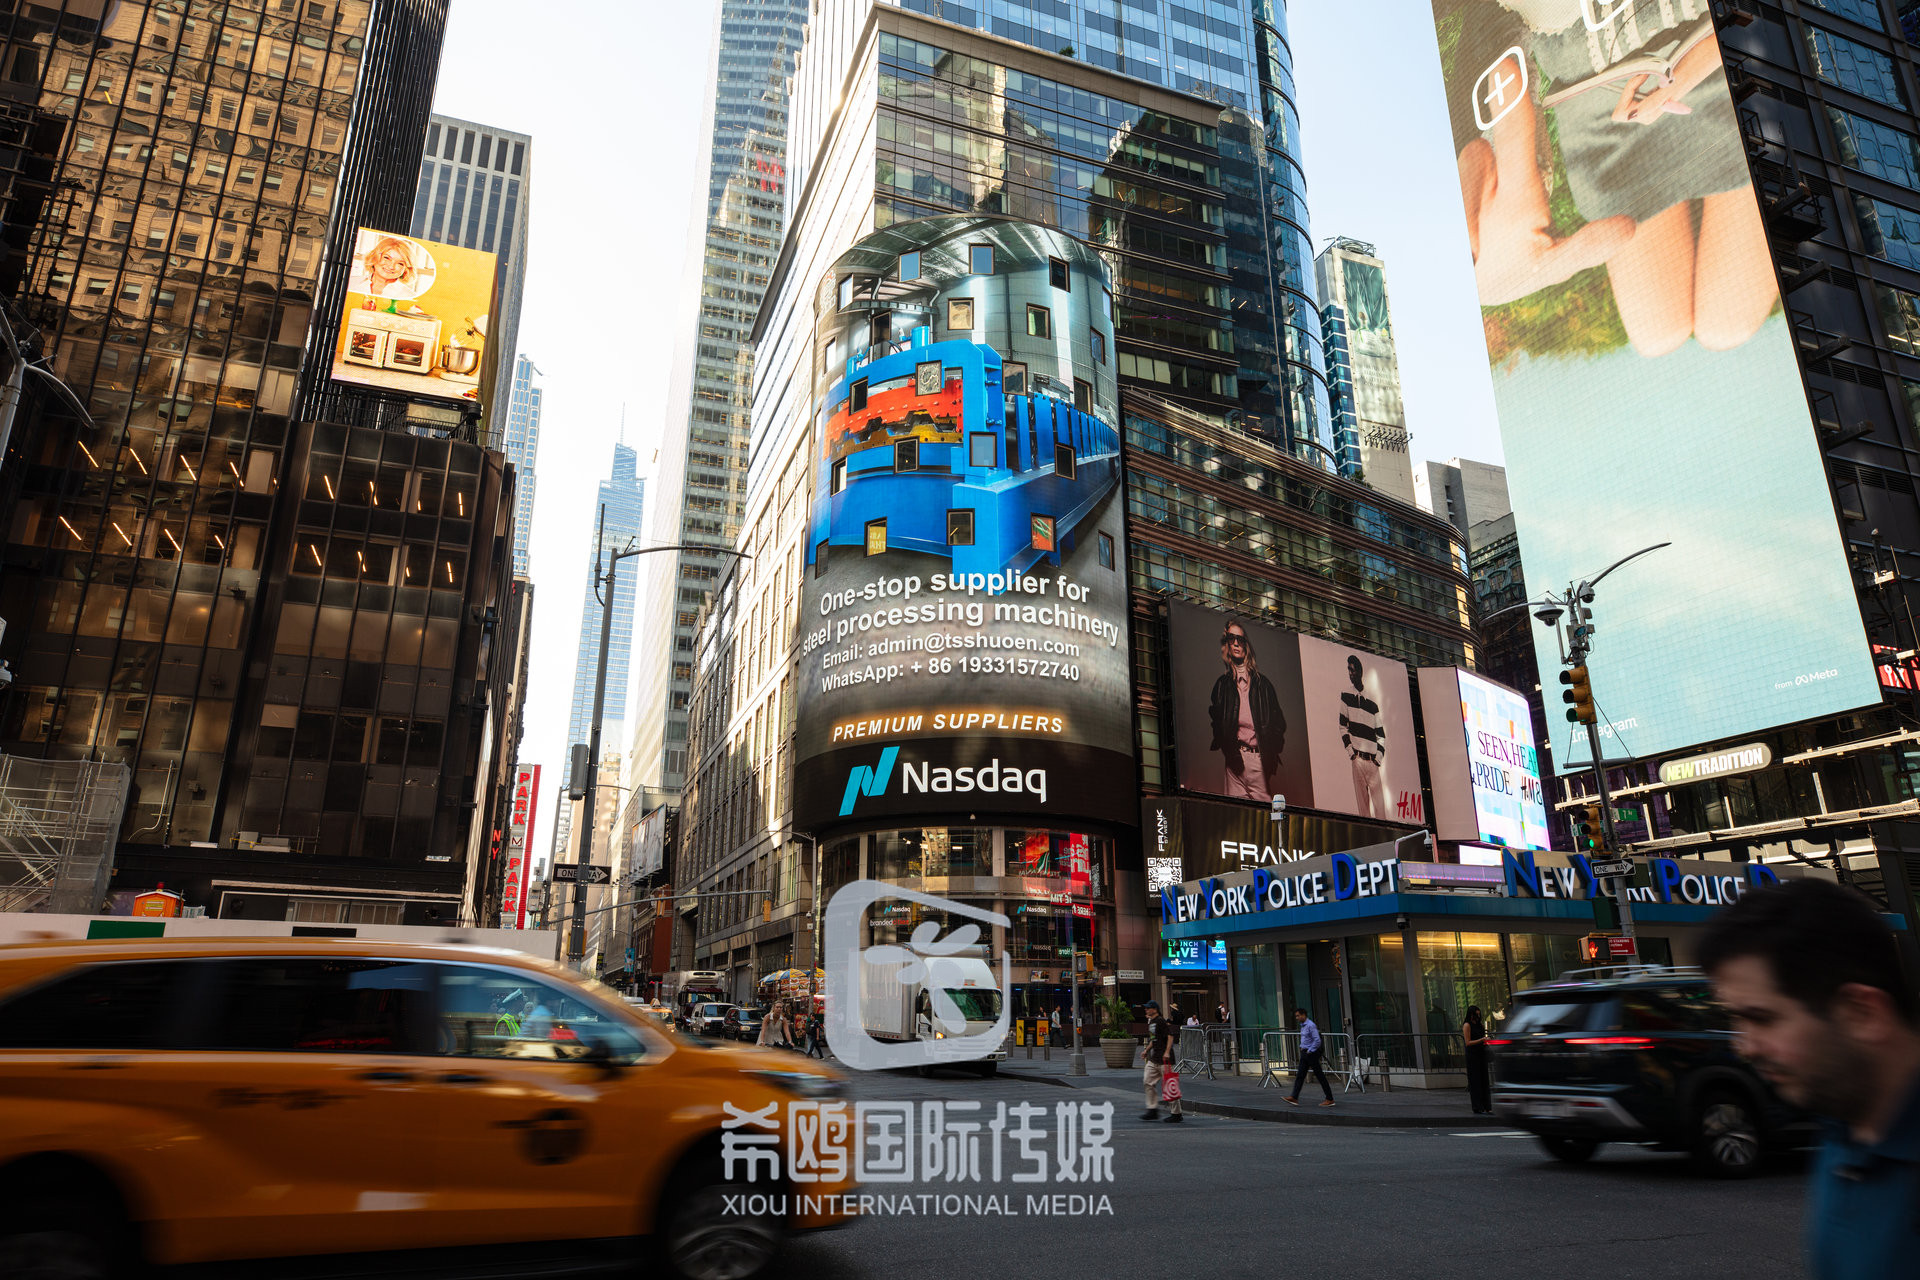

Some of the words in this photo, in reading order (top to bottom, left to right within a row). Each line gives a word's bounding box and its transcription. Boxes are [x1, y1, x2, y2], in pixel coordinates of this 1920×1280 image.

[820, 575, 921, 616] One-stop
[930, 569, 1049, 596] supplier
[1057, 575, 1090, 603] for
[803, 624, 831, 656] steel
[837, 598, 984, 642] processing
[994, 603, 1119, 647] machinery
[823, 643, 863, 670] Email:
[868, 632, 1080, 657] admin@tsshuoen.com
[822, 660, 904, 693] WhatsApp:
[928, 658, 952, 674] 86
[958, 657, 1080, 681] 19331572740
[1775, 681, 1793, 690] from
[1808, 669, 1838, 682] Meta
[833, 715, 923, 742] PREMIUM
[933, 713, 1063, 733] SUPPLIERS
[1571, 717, 1638, 743] Insagram
[513, 772, 531, 825] PARK
[902, 759, 1048, 803] Nasdaq
[1397, 790, 1421, 822] H&M
[1156, 809, 1165, 852] FRANK
[503, 857, 521, 912] PARK
[1503, 849, 1575, 899] NEW
[1595, 865, 1609, 874] ONE
[1615, 864, 1629, 873] WAY
[1161, 885, 1200, 924] NEW
[1199, 878, 1251, 918] YORK
[1253, 868, 1327, 912] POLICE
[1331, 852, 1399, 900] DEPT
[892, 906, 911, 914] Nasdaq
[1027, 904, 1047, 914] Nasdaq
[1168, 947, 1198, 958] LIVE
